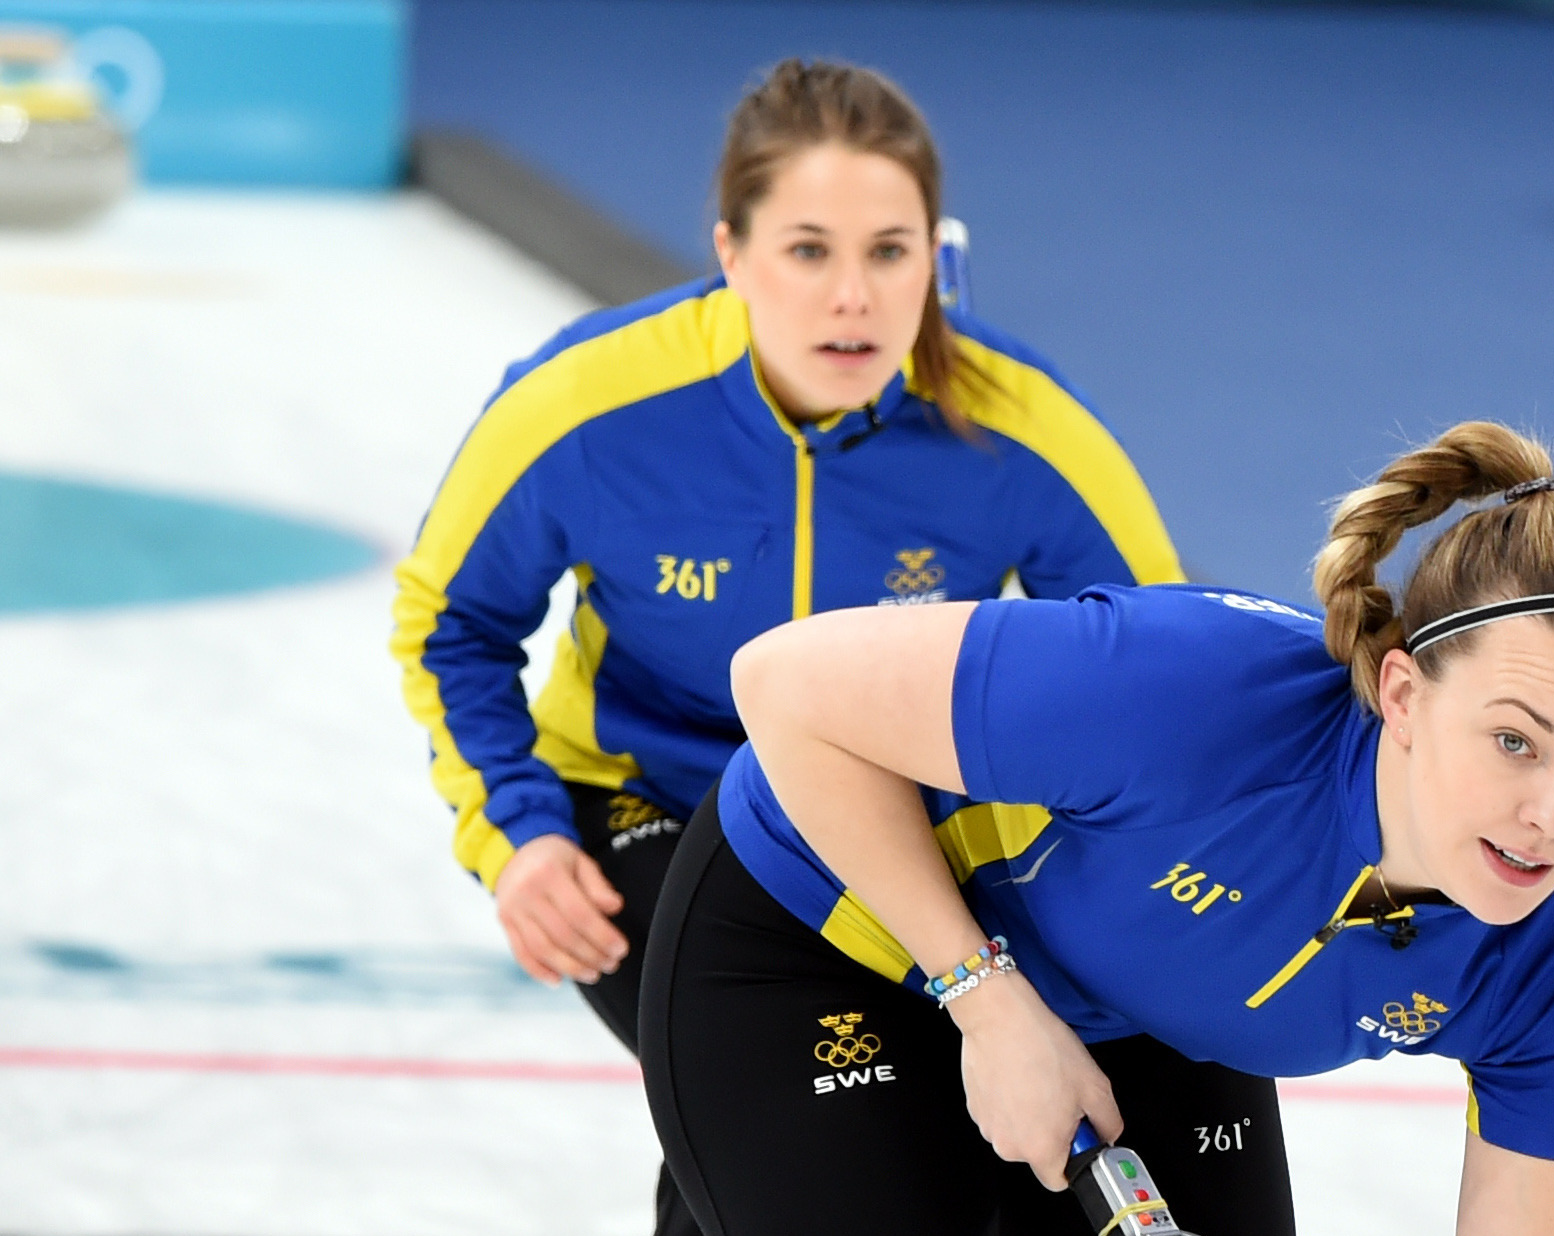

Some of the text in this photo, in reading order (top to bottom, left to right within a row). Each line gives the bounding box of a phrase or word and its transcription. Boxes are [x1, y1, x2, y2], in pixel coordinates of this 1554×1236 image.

[655, 553, 731, 602] 361°
[1150, 863, 1242, 915] 361°
[1355, 1015, 1427, 1045] SWE
[813, 1065, 897, 1095] SWE
[1194, 1117, 1251, 1154] 361°
